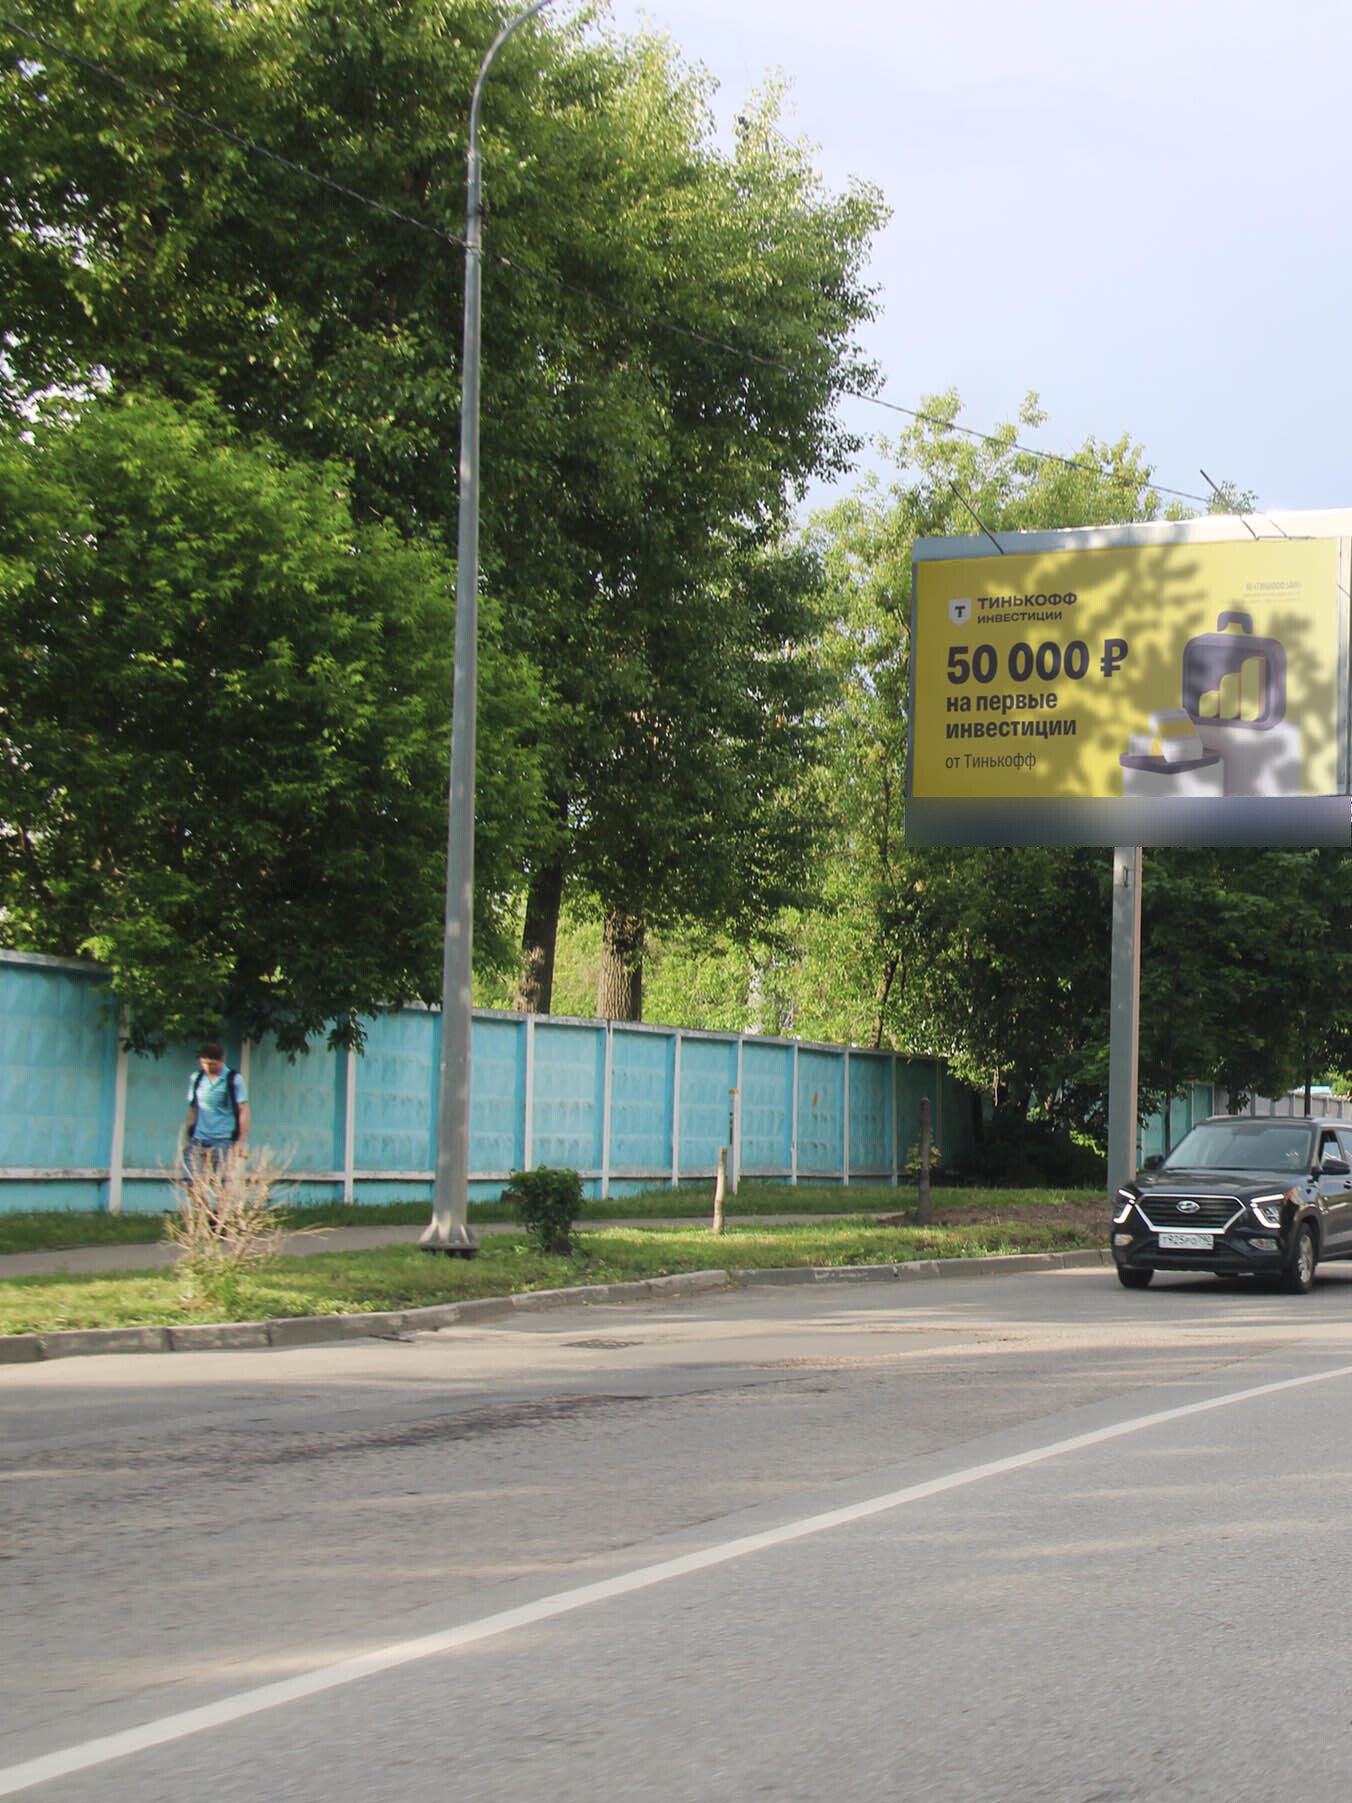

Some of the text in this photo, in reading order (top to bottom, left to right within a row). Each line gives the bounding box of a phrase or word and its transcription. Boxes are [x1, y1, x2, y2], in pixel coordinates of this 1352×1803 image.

[977, 592, 1077, 610] ТИНЬКОФФ
[977, 611, 1062, 624] ИНВЕСТИЦИИ
[947, 644, 998, 684] 50
[1008, 640, 1090, 682] 000
[946, 692, 1058, 715] на первые
[946, 720, 1077, 739] инвестиции
[945, 752, 1036, 770] от Тинькофф
